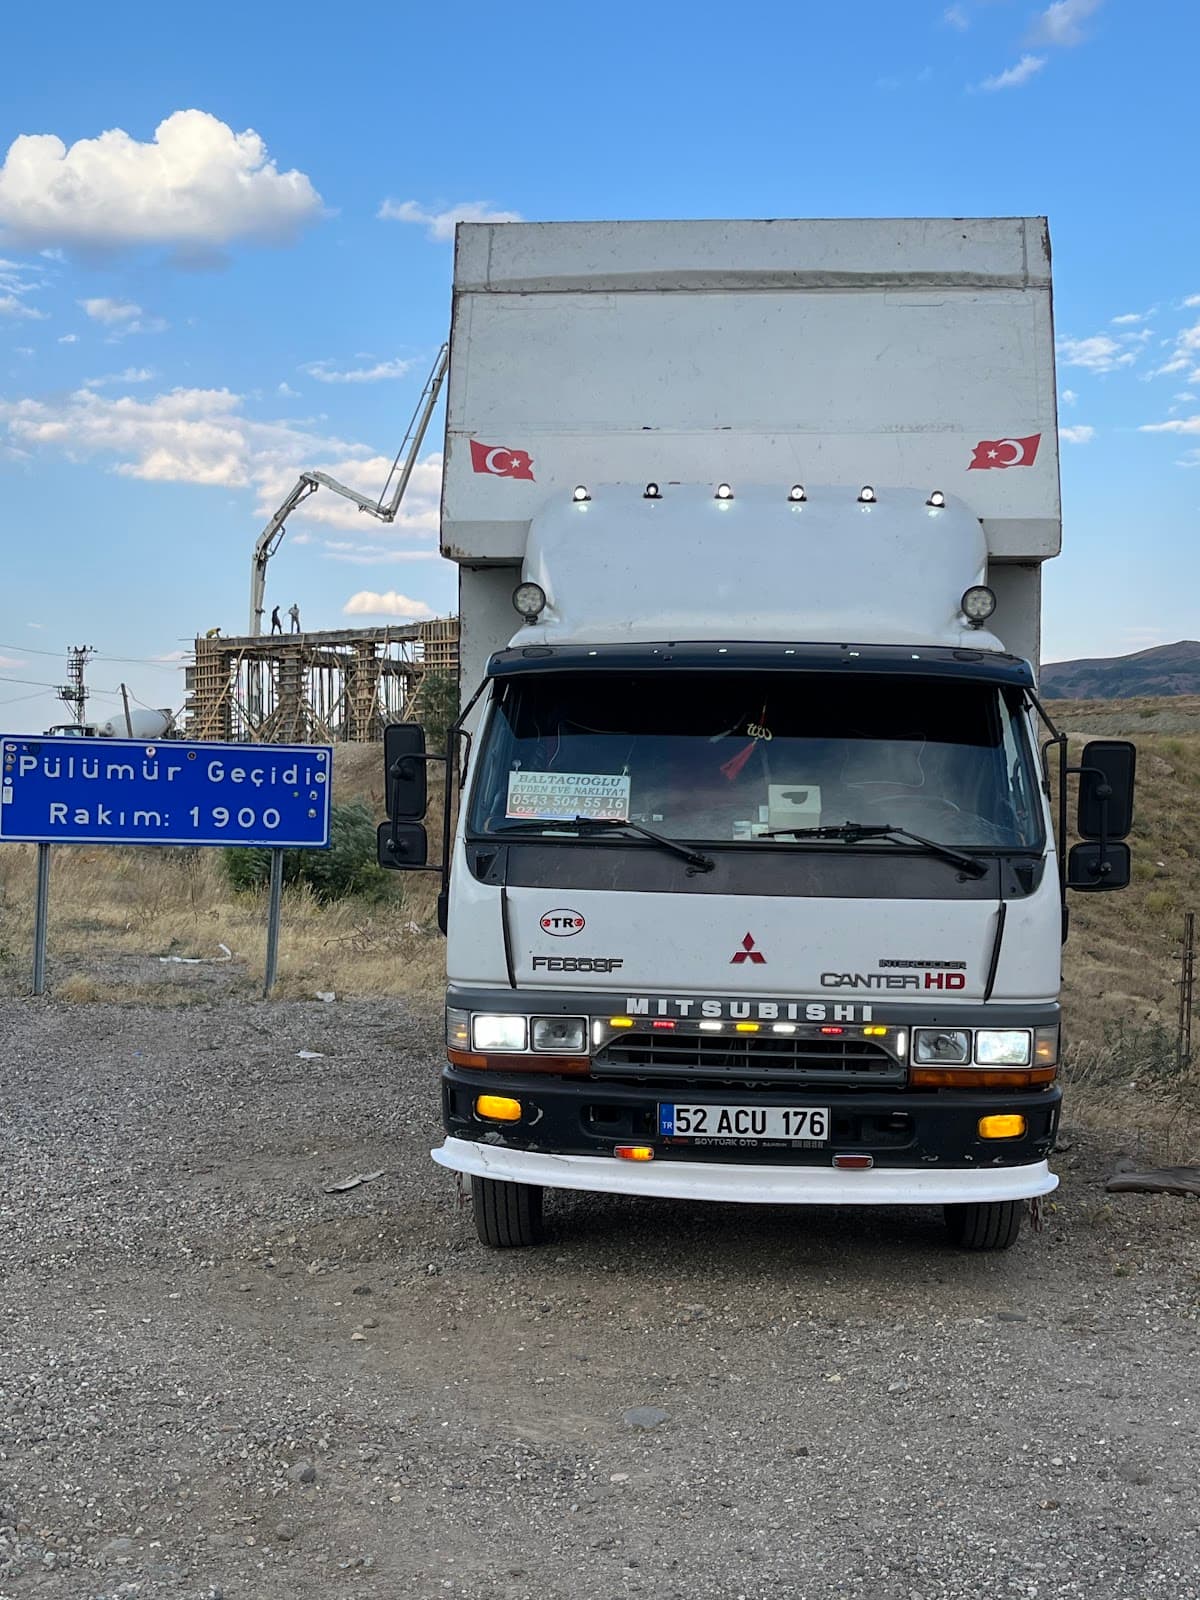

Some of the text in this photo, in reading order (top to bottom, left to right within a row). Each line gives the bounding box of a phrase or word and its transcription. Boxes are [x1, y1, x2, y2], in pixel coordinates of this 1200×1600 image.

[19, 755, 312, 787] Pülümür Geçidi
[512, 784, 547, 794] EVDEN
[550, 785, 570, 795] EVE
[583, 797, 602, 808] 55
[606, 798, 624, 809] 16
[49, 802, 281, 829] Rakım: 1900
[551, 917, 574, 928] TR
[878, 959, 967, 970] INTERCOOLER
[820, 972, 966, 990] CANTER HD
[625, 997, 873, 1022] MITSUBISHI
[662, 1108, 825, 1137] TR 52 ACU 176
